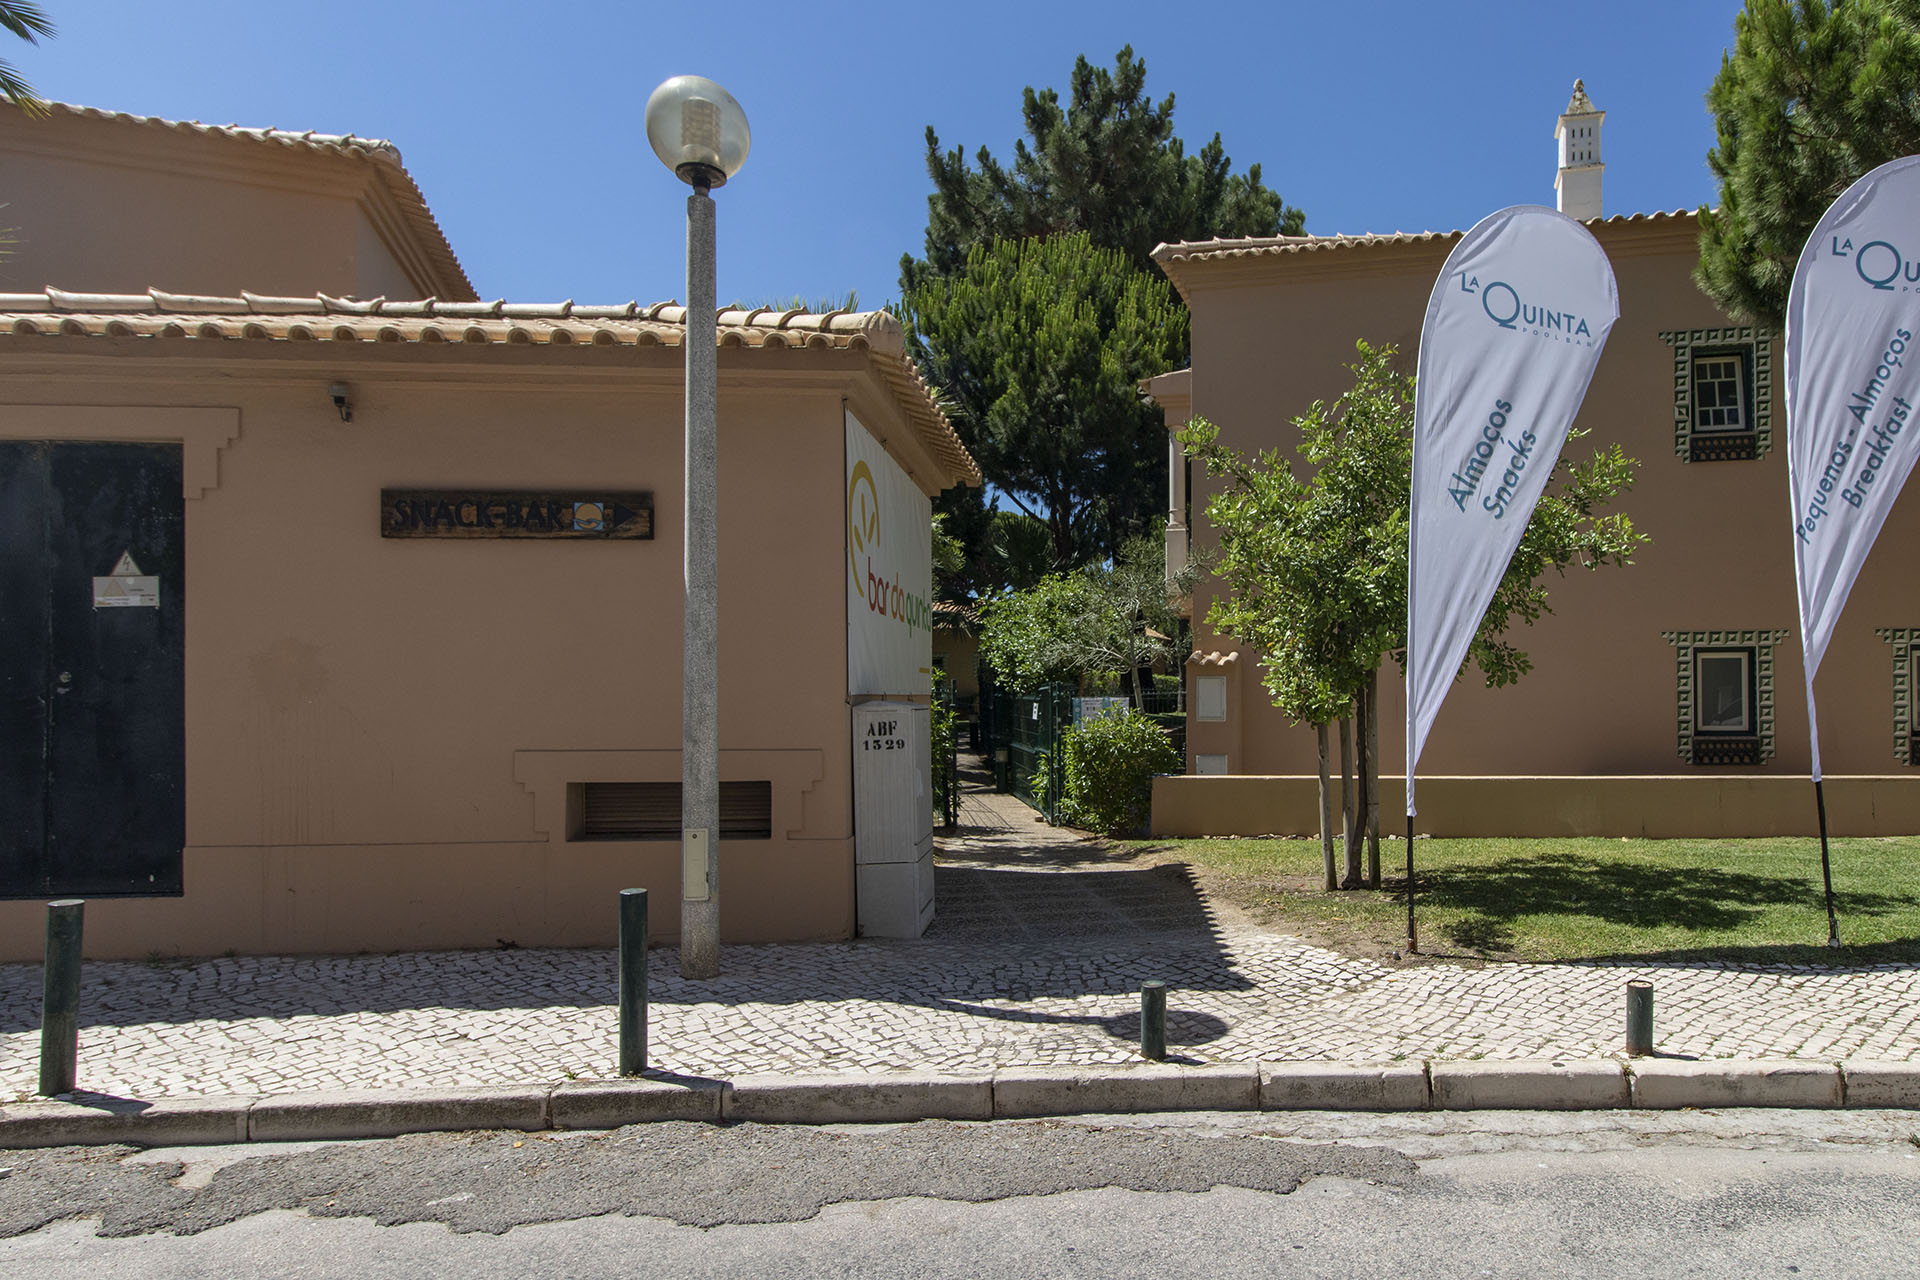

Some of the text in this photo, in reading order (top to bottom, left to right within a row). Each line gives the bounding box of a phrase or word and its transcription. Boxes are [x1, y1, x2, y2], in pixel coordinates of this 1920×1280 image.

[1832, 236, 1853, 256] LA
[1461, 272, 1591, 338] LA QUINTA
[1447, 398, 1512, 512] Almoços
[1482, 429, 1536, 519] Snacks
[1796, 441, 1852, 544] Pequenos
[1847, 328, 1912, 425] Almoços
[1840, 397, 1912, 508] Breakfast
[868, 556, 889, 616] bar
[891, 571, 905, 623] da
[867, 720, 897, 736] ABF
